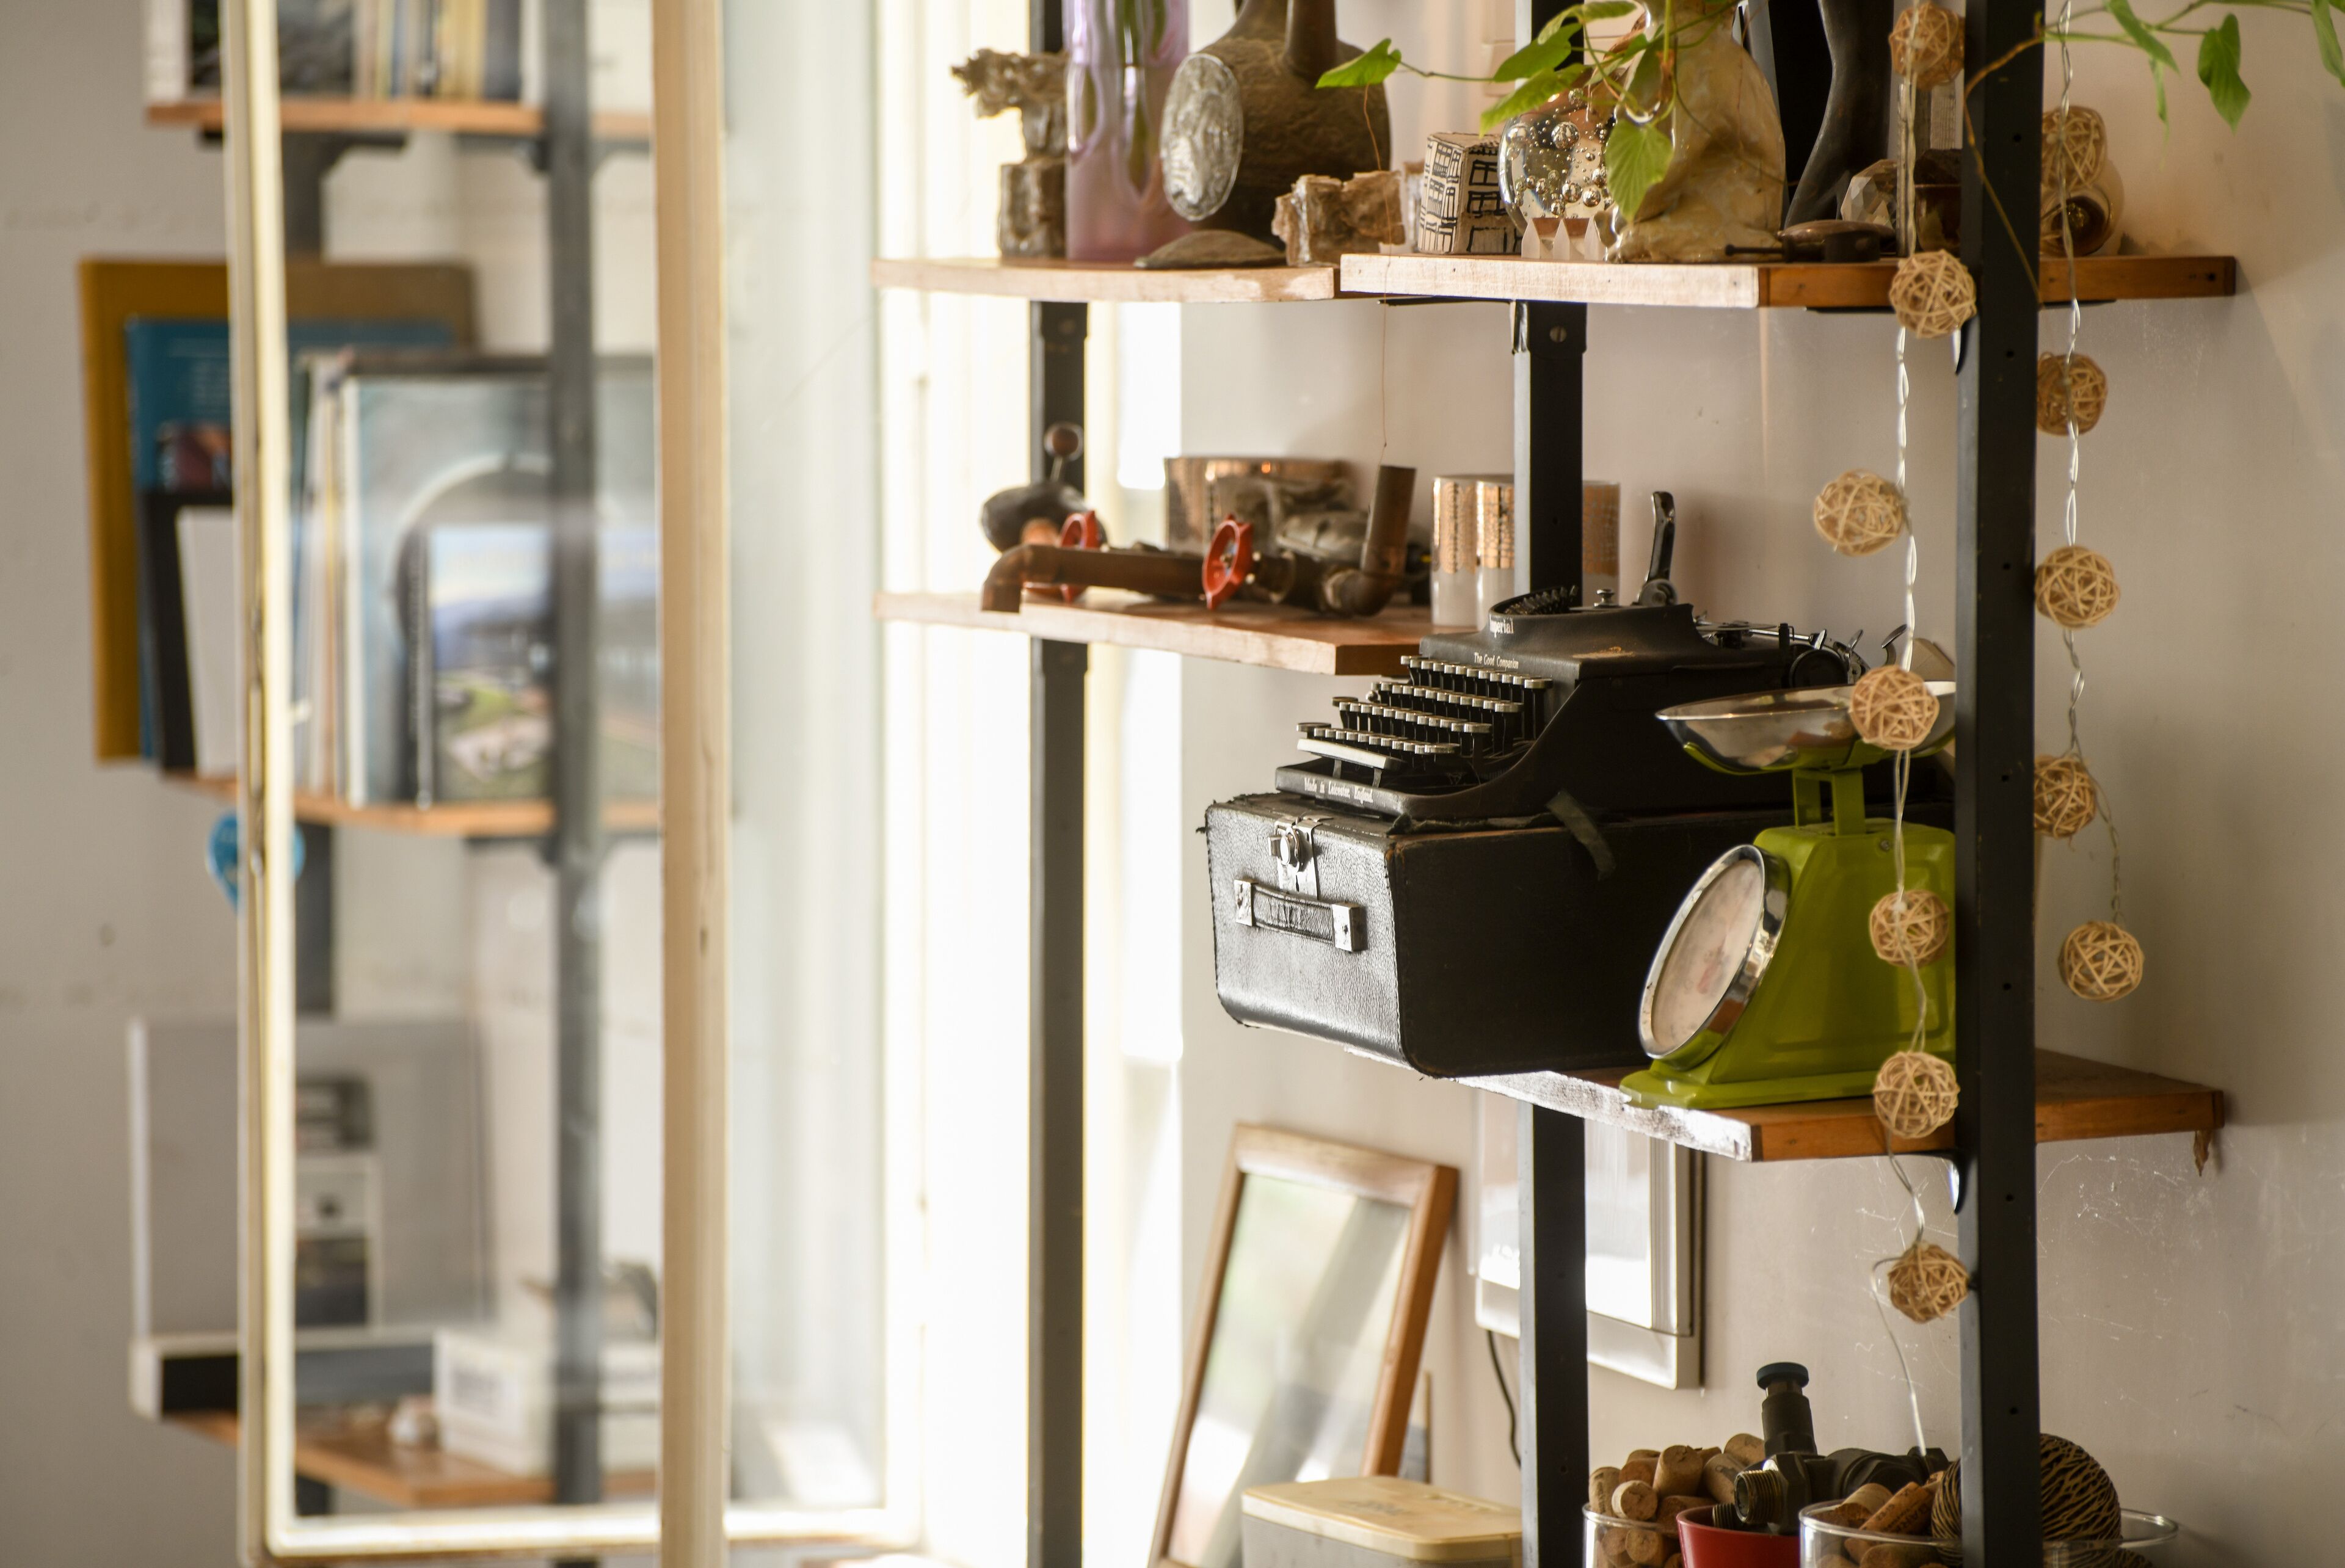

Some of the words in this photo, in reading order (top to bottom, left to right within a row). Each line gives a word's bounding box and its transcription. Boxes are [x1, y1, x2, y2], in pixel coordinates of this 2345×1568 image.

[1474, 652, 1483, 664] The
[1484, 654, 1495, 666] Good
[1497, 656, 1519, 671] Companion
[1304, 777, 1317, 793] Made
[1320, 781, 1325, 793] in
